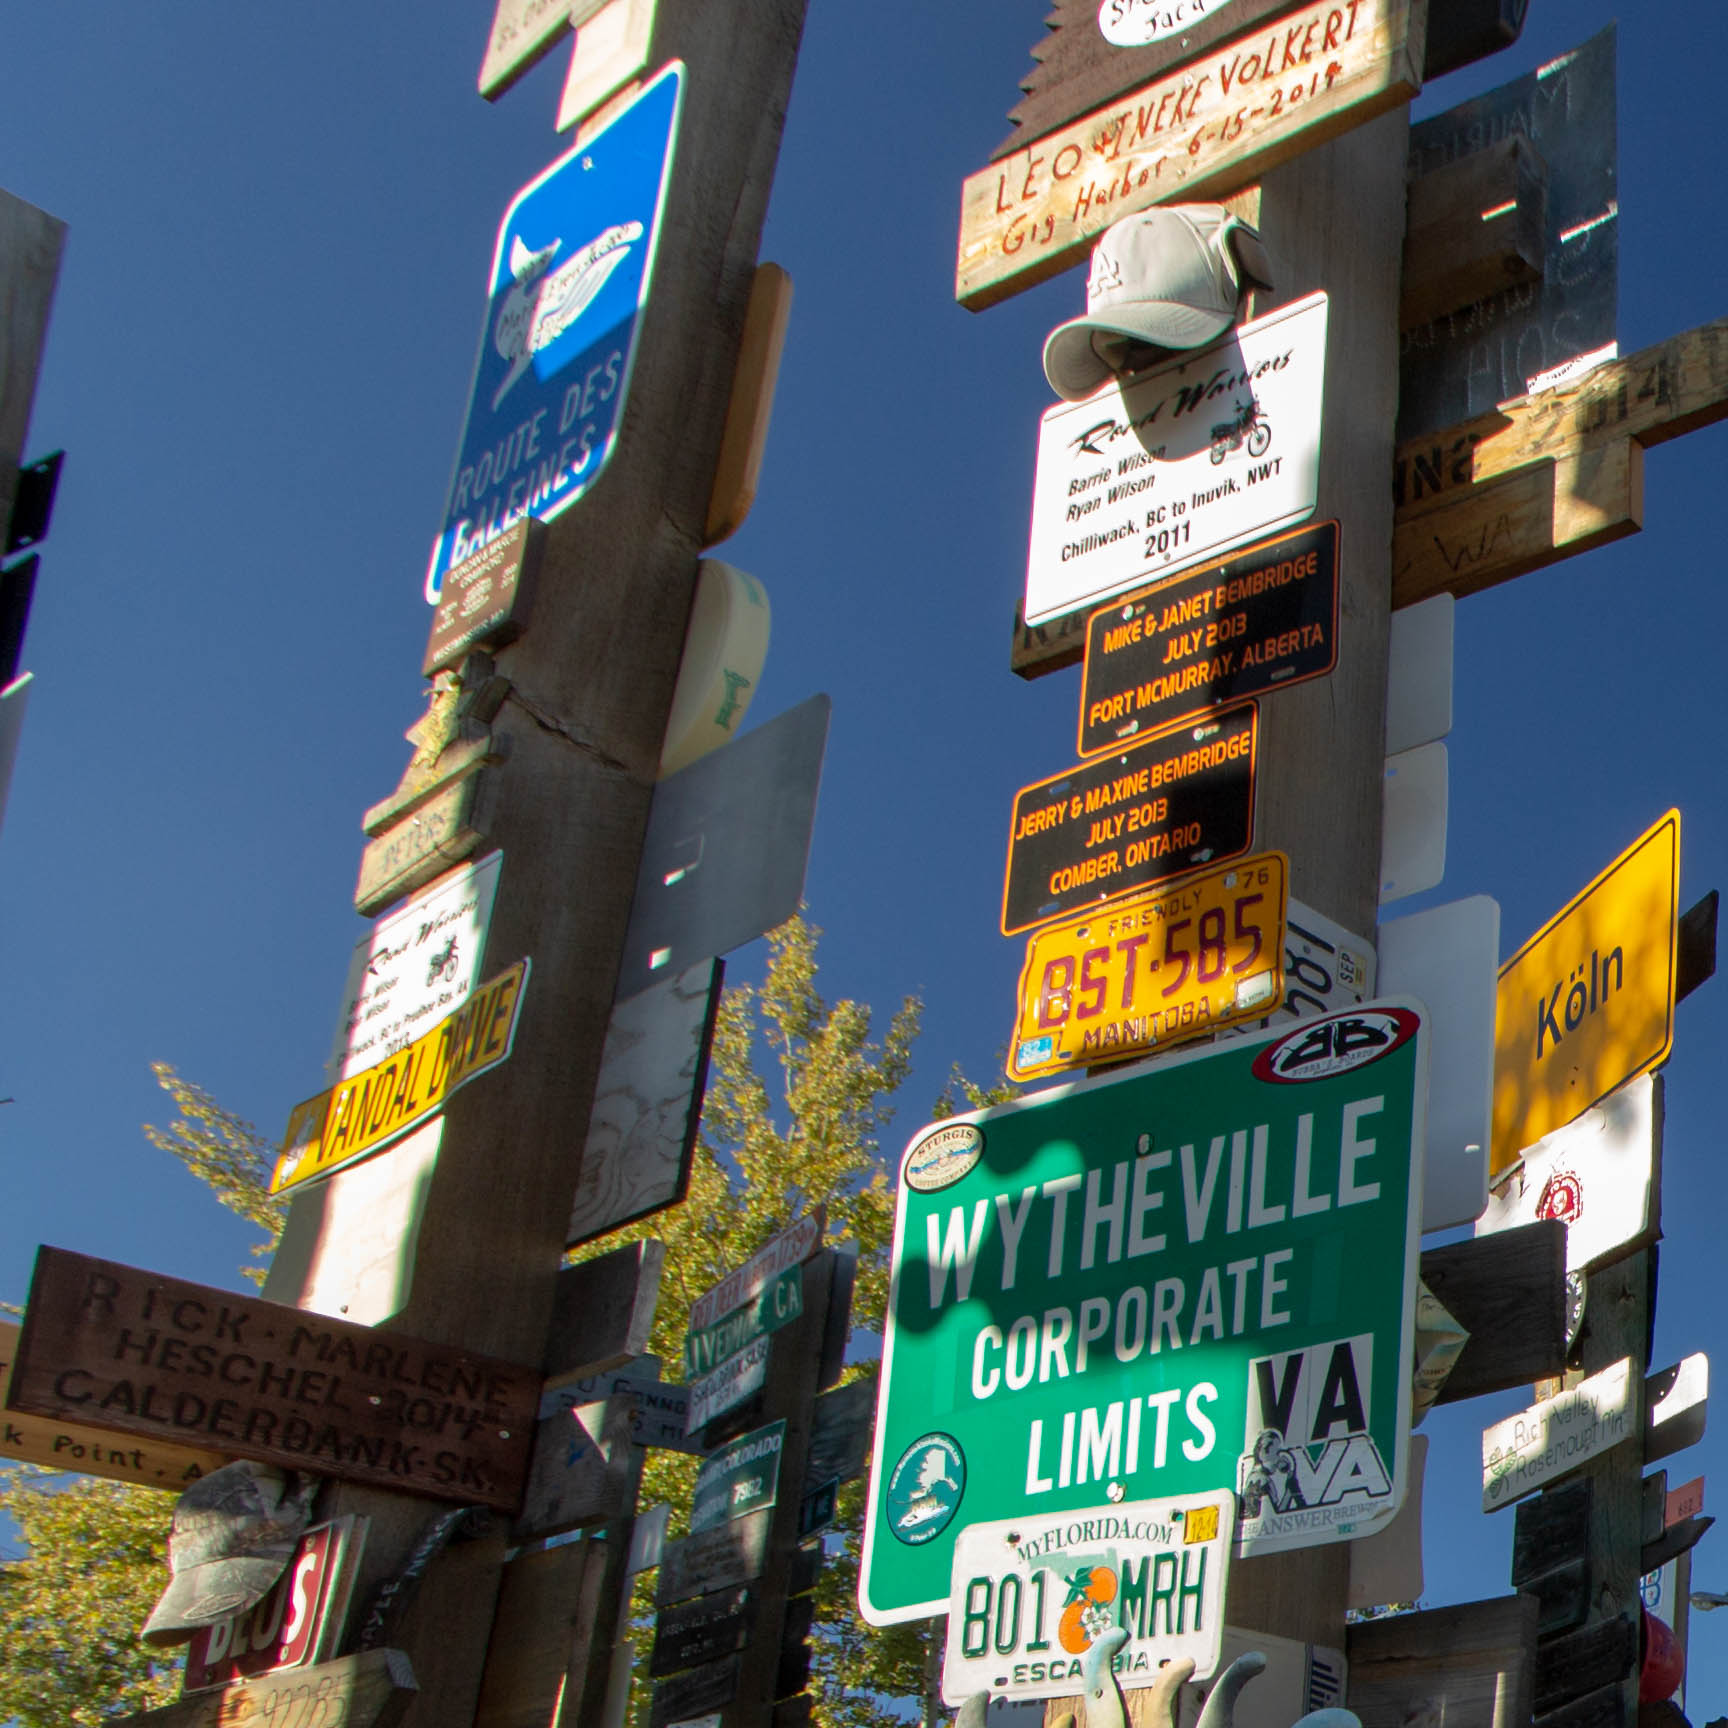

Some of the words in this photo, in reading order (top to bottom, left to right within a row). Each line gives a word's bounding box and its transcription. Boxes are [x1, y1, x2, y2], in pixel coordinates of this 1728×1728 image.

[456, 408, 548, 513] ROUTE
[559, 352, 624, 435] DES
[1060, 519, 1138, 564] Chilliwack,
[1145, 503, 1166, 529] BC
[1171, 500, 1187, 520] to
[1191, 484, 1242, 517] Inuvik,
[1247, 459, 1282, 487] NWT
[1143, 520, 1192, 560] 2011
[1103, 605, 1140, 653] MIKE
[1143, 608, 1157, 636] &
[1159, 589, 1212, 637] JANET
[1214, 553, 1318, 610] BEMBRIDGE
[1162, 628, 1202, 664] JULY
[1206, 614, 1248, 649] 2013
[1090, 691, 1135, 728] FORT
[1138, 656, 1237, 710] MCMURRAY,
[1242, 624, 1325, 670] ALBERTA
[1081, 997, 1211, 1052] MANITOBA
[1535, 942, 1623, 1061] Köln
[315, 1050, 428, 1163] VANDAL
[429, 978, 512, 1099] DRIVE
[926, 1095, 1385, 1308] WYTHEVILLE
[972, 1248, 1294, 1400] CORPORATE
[1025, 1382, 1219, 1495] LIMITS
[1017, 1515, 1173, 1564] MYFLORIDA.COM
[962, 1568, 1049, 1658] 801
[1120, 1547, 1206, 1641] MRH
